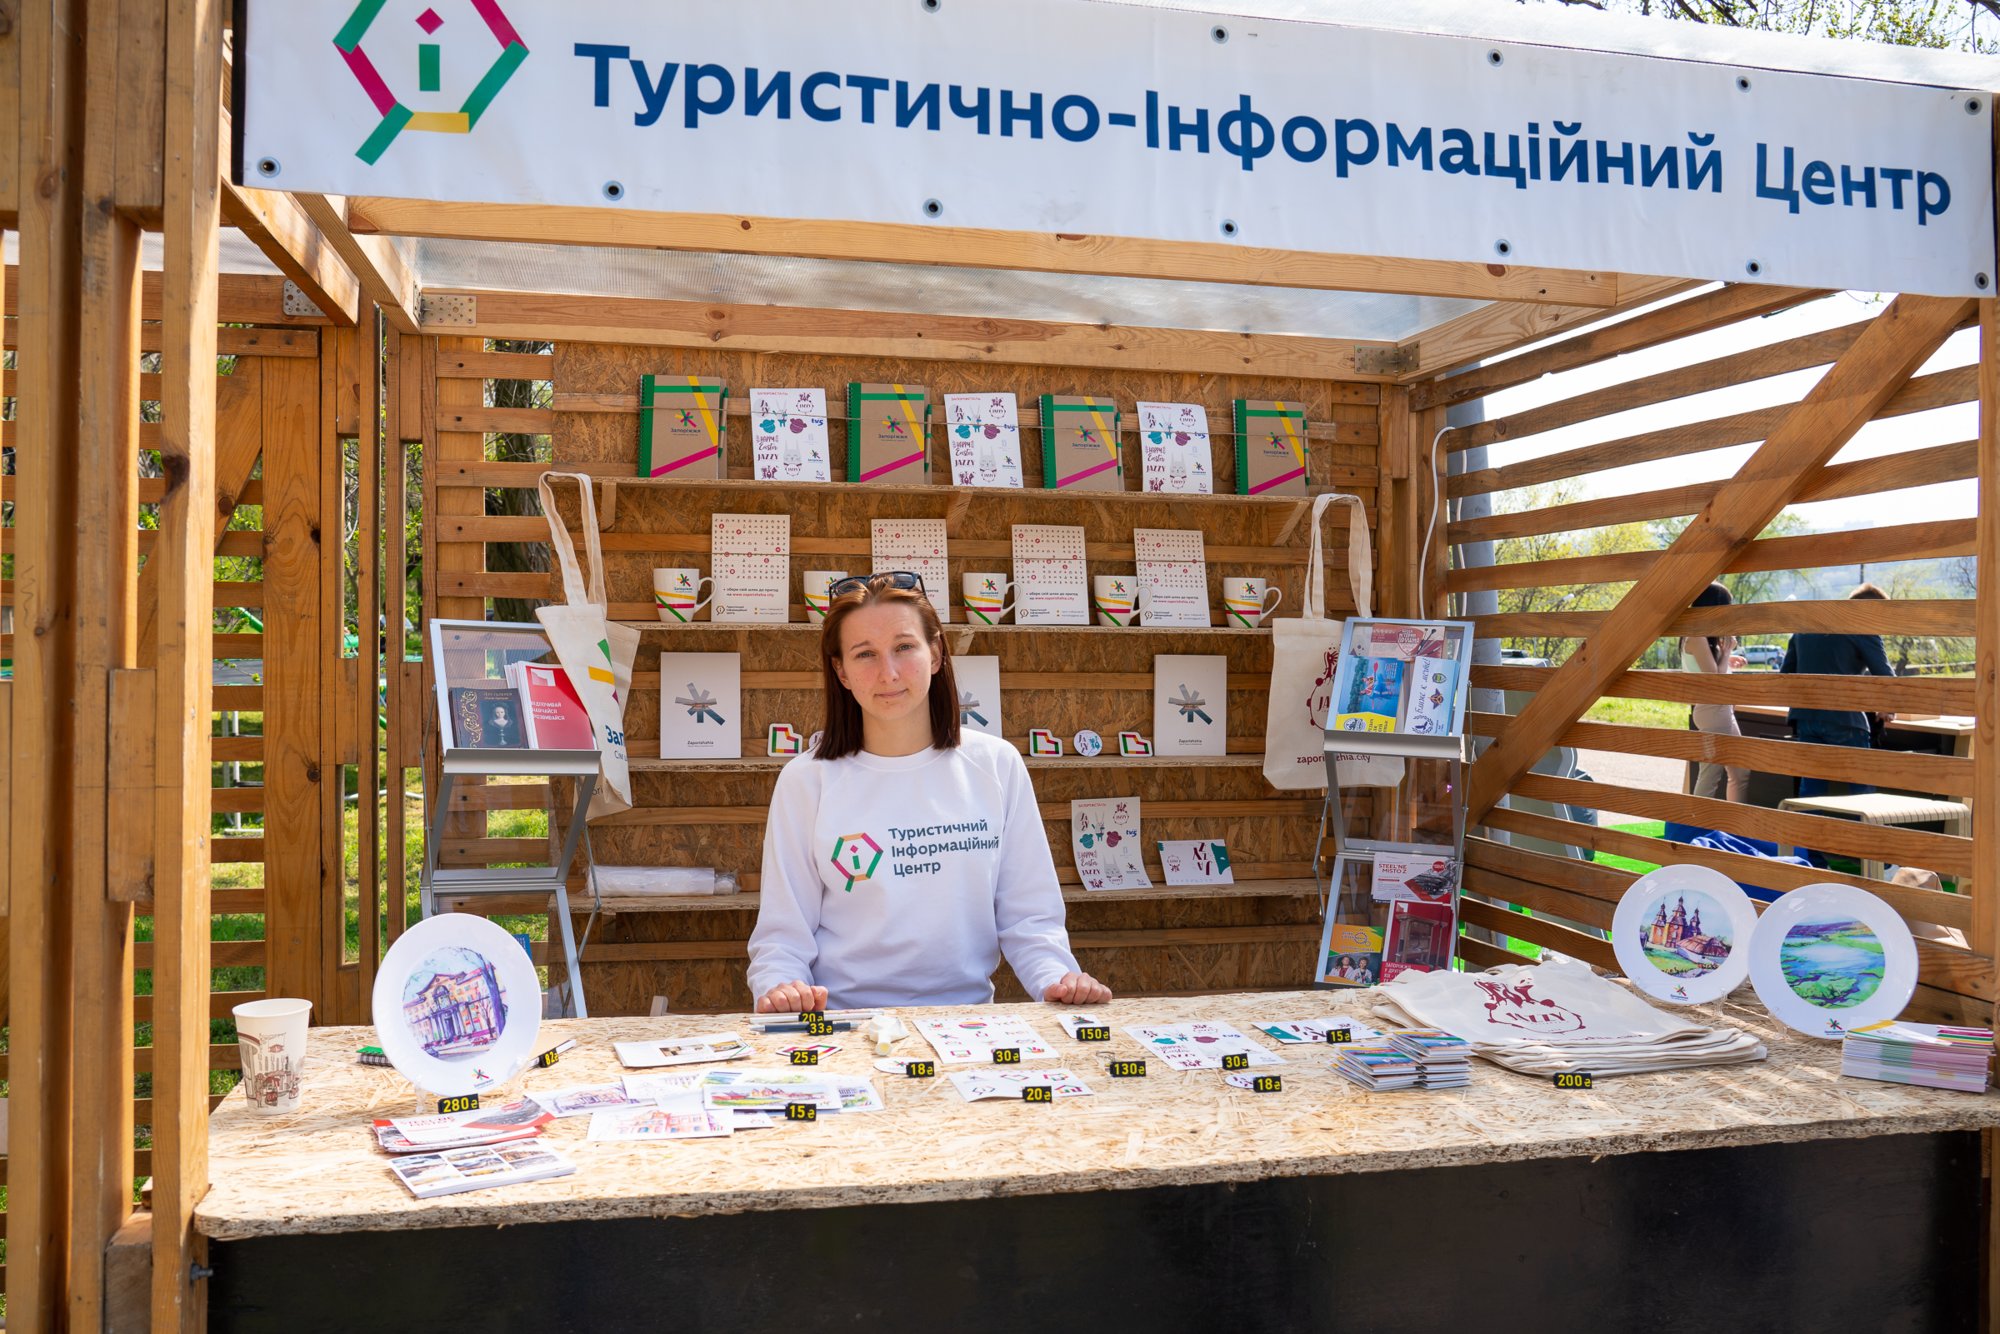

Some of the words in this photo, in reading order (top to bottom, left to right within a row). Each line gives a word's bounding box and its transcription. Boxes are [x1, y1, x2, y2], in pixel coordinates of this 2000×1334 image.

[573, 43, 1724, 194] Туристично-Інформаційний
[1755, 142, 1952, 227] Центр
[1297, 753, 1371, 765] zaporizhia.city
[887, 819, 989, 842] Туристичний
[891, 836, 1001, 859] Інформаційний
[893, 861, 942, 878] Центр
